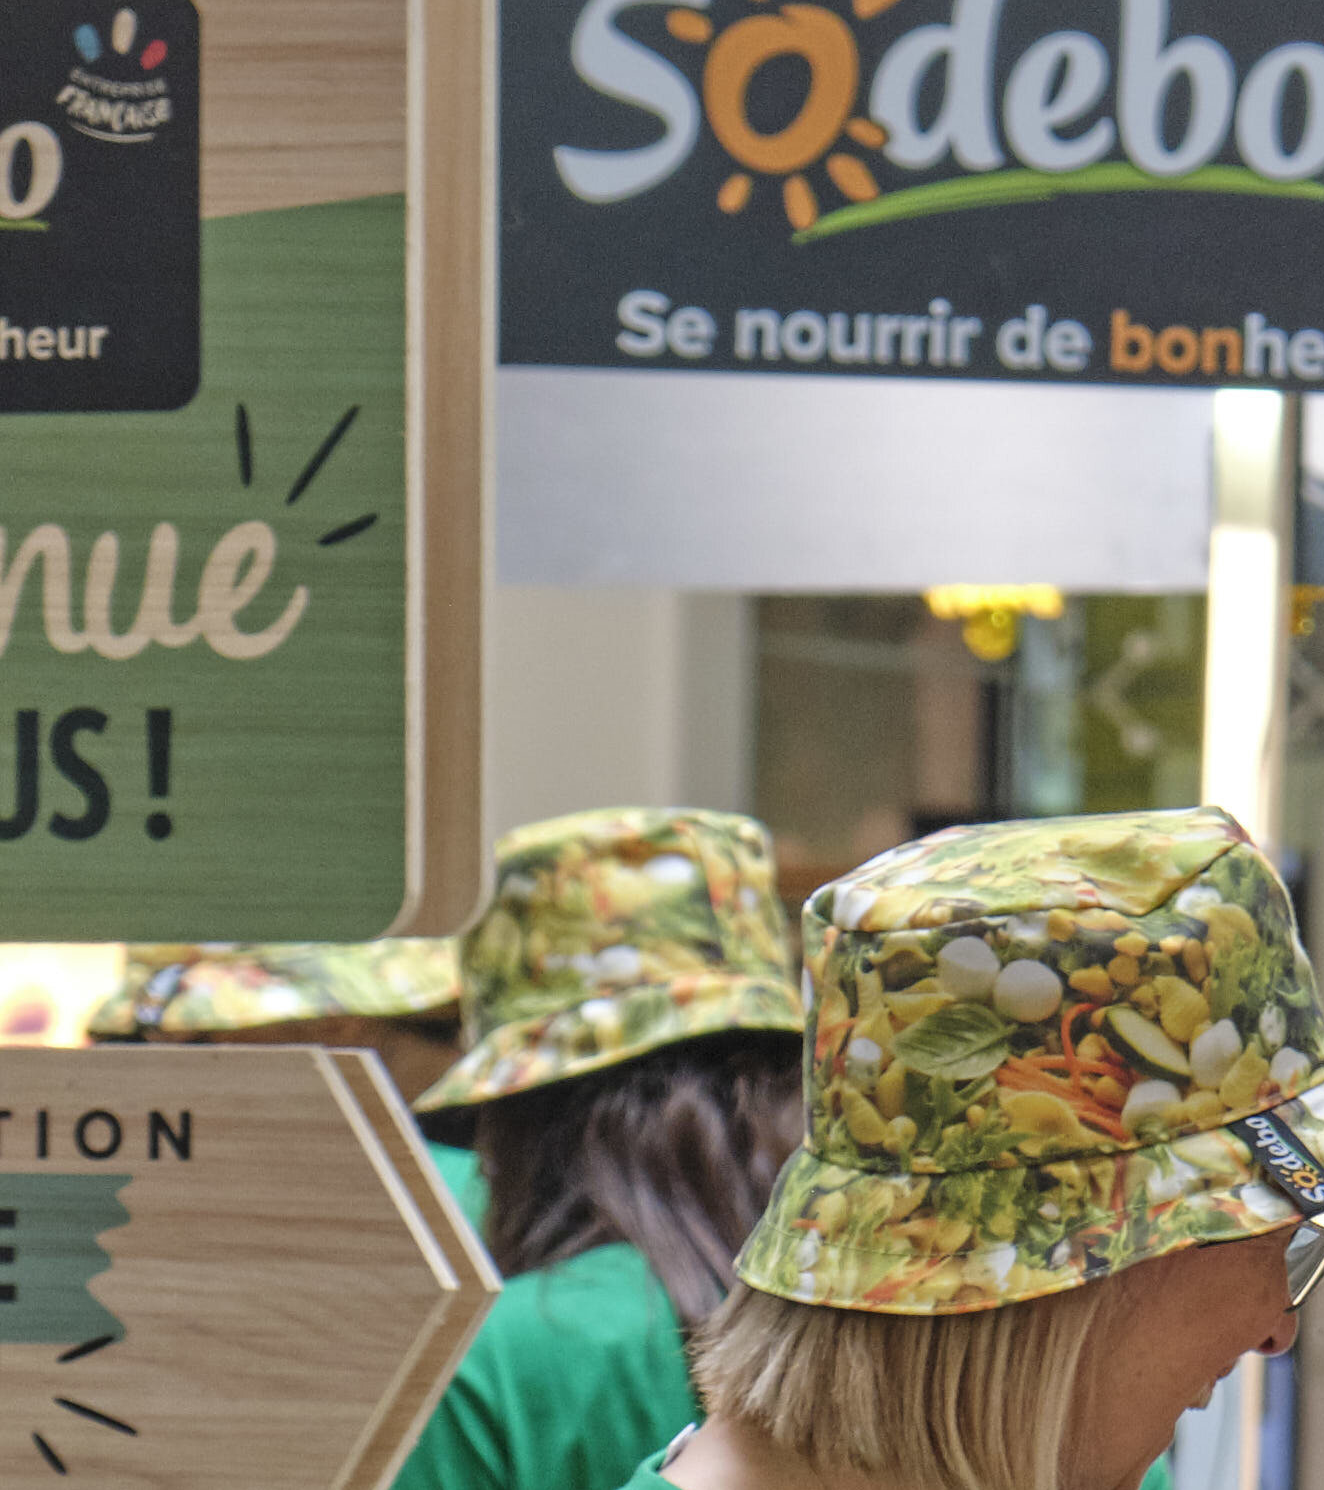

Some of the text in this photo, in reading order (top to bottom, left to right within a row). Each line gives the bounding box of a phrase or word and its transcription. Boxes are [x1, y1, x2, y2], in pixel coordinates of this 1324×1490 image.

[615, 290, 716, 359] Se
[734, 298, 983, 368] nourrir
[996, 306, 1093, 372] de
[0, 1108, 191, 1160] ION
